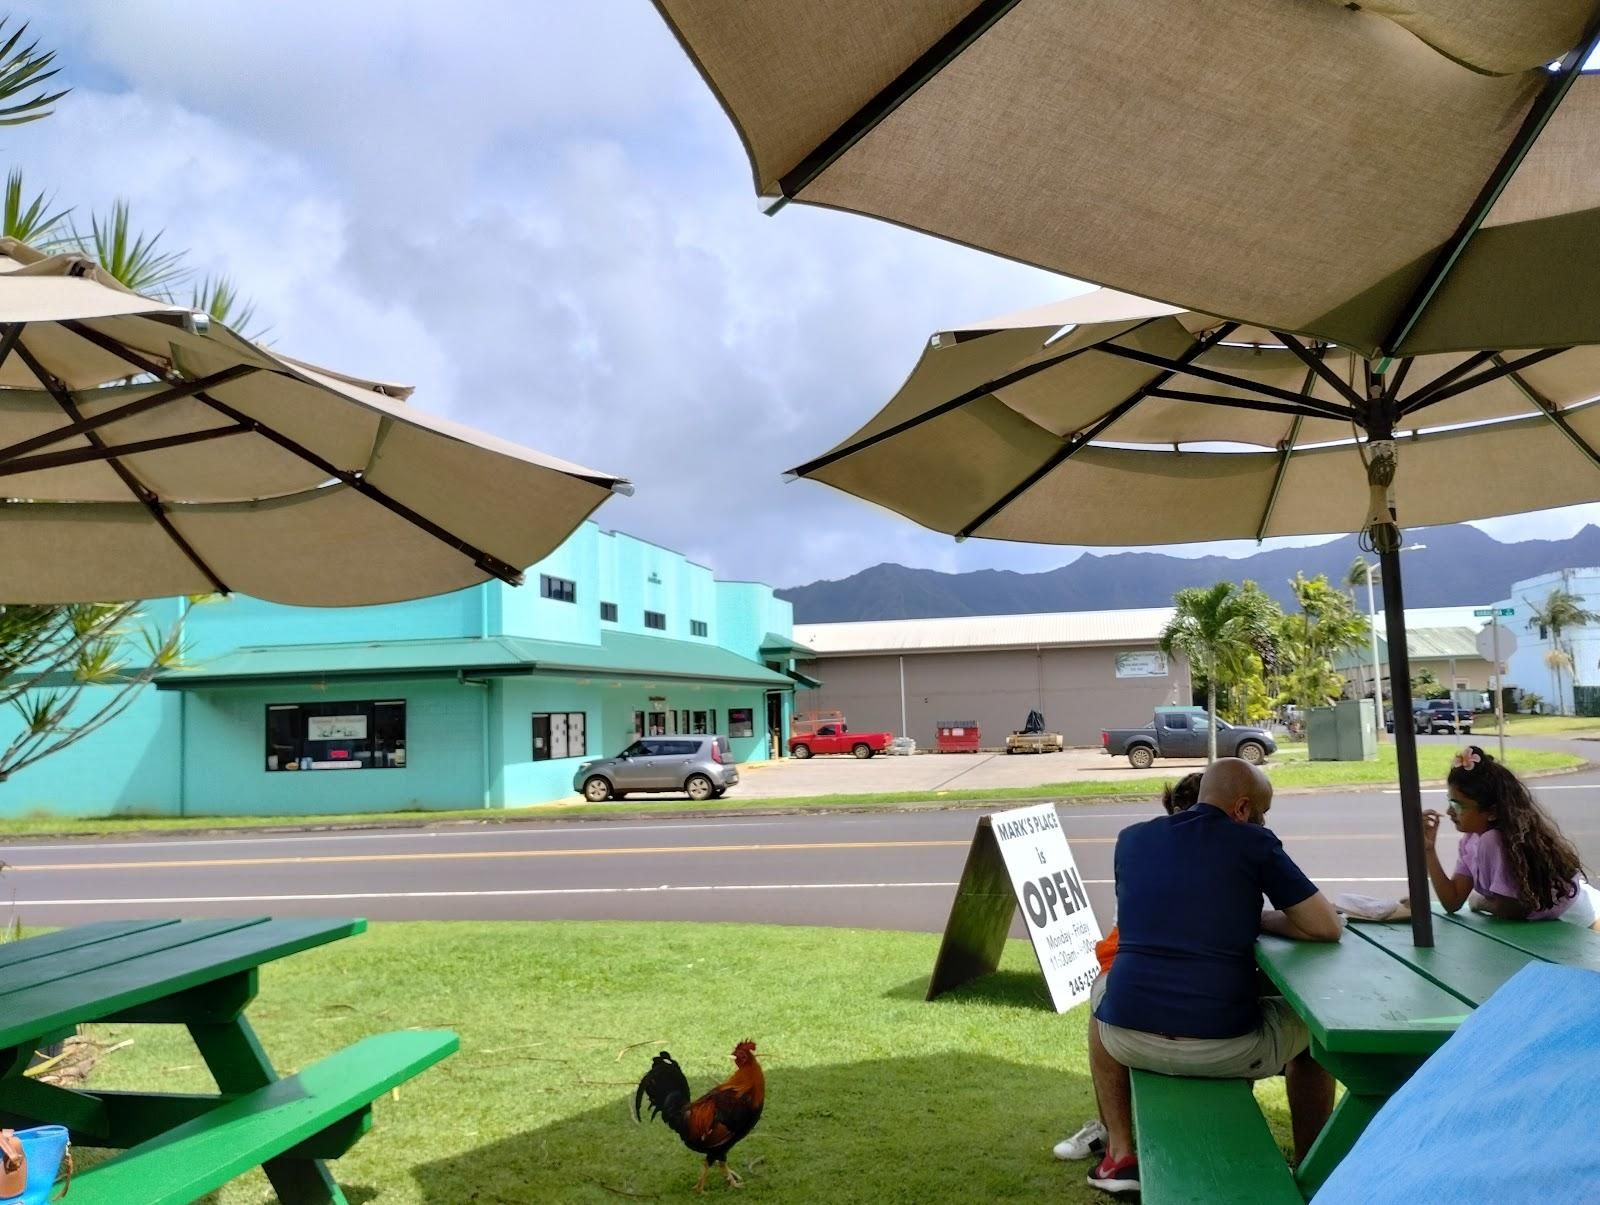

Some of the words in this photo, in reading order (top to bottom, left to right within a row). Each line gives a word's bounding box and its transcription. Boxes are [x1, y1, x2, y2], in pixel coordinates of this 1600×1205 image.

[997, 817, 1034, 841] MARK'S
[1032, 812, 1058, 832] PLACE
[1022, 867, 1088, 928] OPEN
[1046, 930, 1073, 950] Monday
[1072, 921, 1090, 937] Friday
